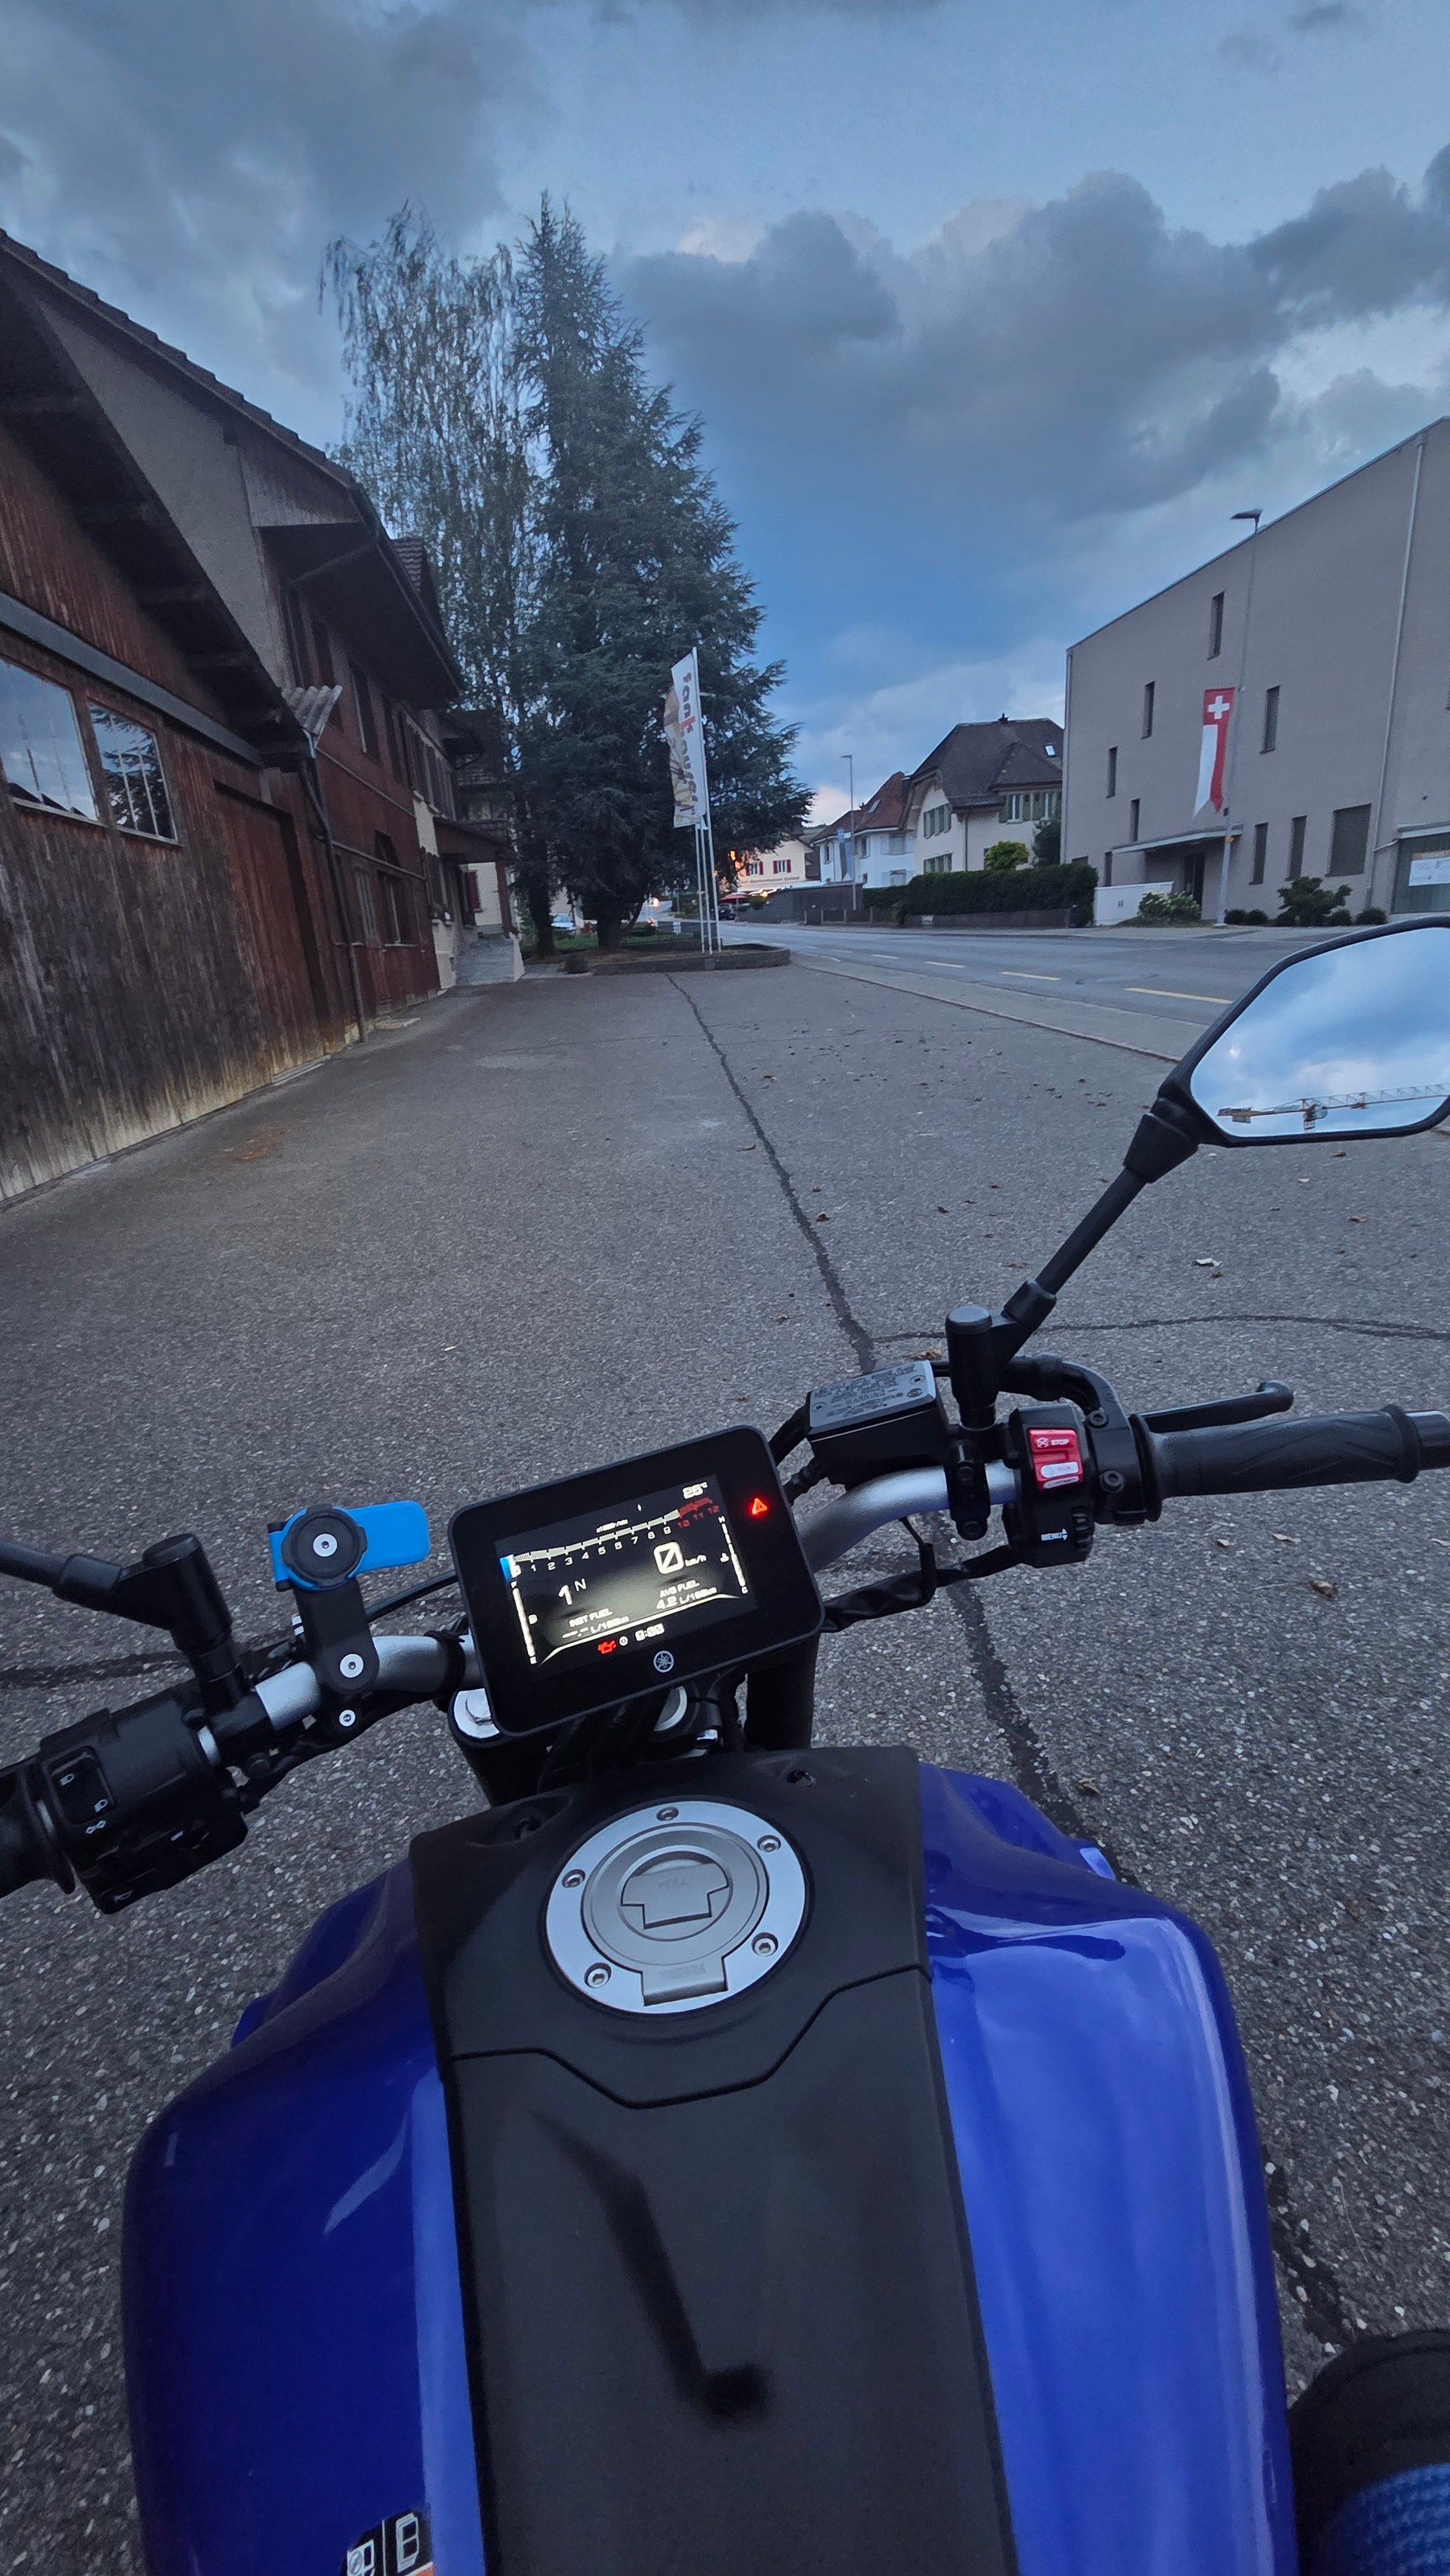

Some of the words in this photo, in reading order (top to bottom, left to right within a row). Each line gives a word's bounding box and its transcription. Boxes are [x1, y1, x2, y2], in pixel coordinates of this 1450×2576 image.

[548, 1562, 556, 1571] 2
[565, 1557, 573, 1565] 3
[598, 1546, 606, 1555] 5
[614, 1541, 622, 1549] 6
[631, 1536, 638, 1544] 7
[647, 1531, 655, 1540] 8
[663, 1526, 671, 1534] 9
[677, 1519, 690, 1529] 10
[708, 1505, 719, 1515] 12
[558, 1585, 572, 1605] 1
[575, 1578, 587, 1592] N
[660, 1586, 677, 1598] AVG
[677, 1580, 700, 1592] FUEL
[656, 1595, 677, 1610] 4.2
[589, 1608, 613, 1620] FUEL
